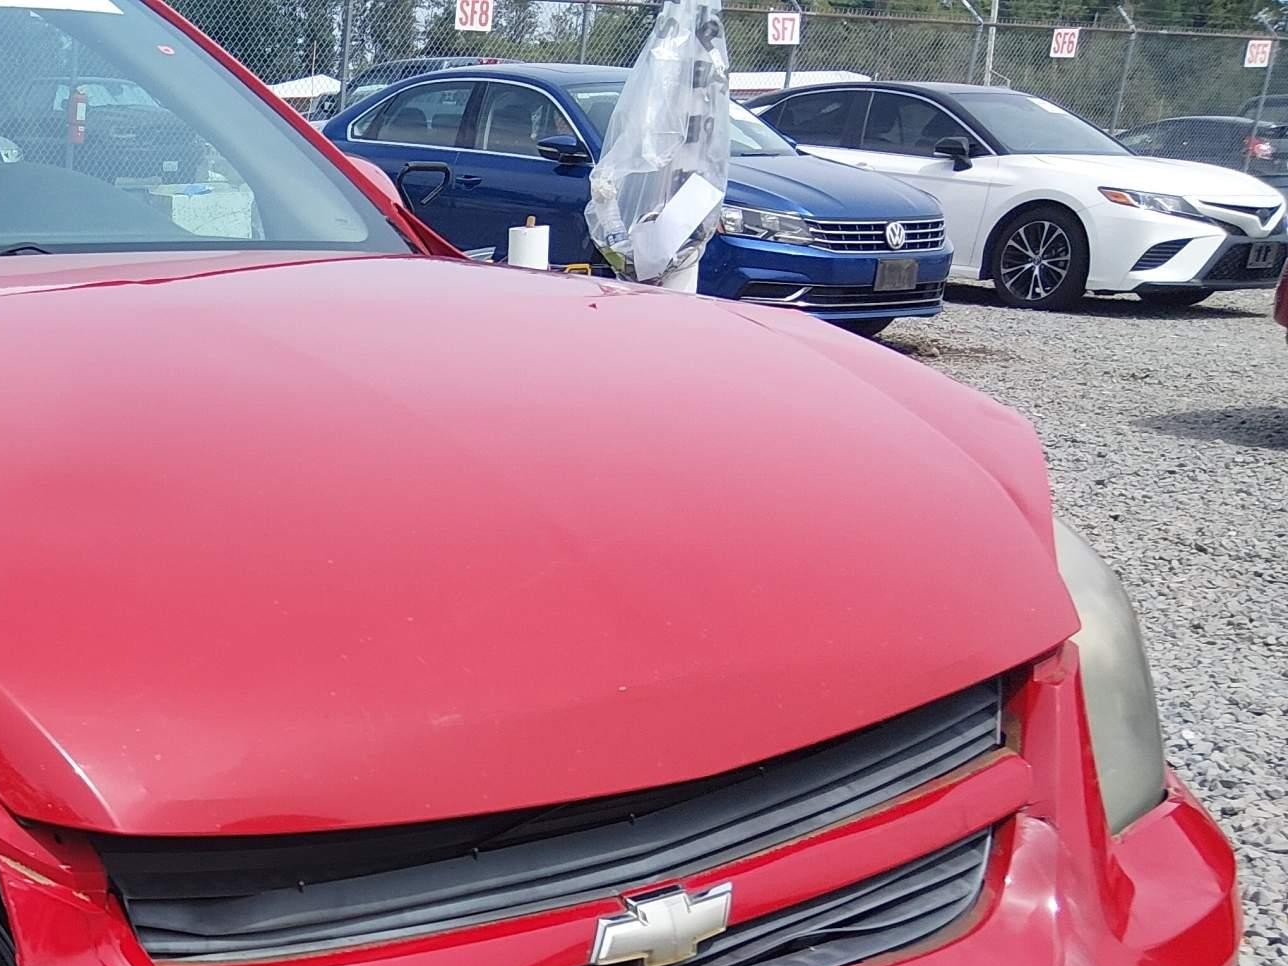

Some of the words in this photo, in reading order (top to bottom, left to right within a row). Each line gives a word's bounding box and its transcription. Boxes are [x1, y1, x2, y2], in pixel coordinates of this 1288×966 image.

[458, 0, 490, 27] SF8
[772, 16, 796, 42] SF7
[1053, 31, 1076, 54] SF6
[1247, 43, 1269, 64] SF5
